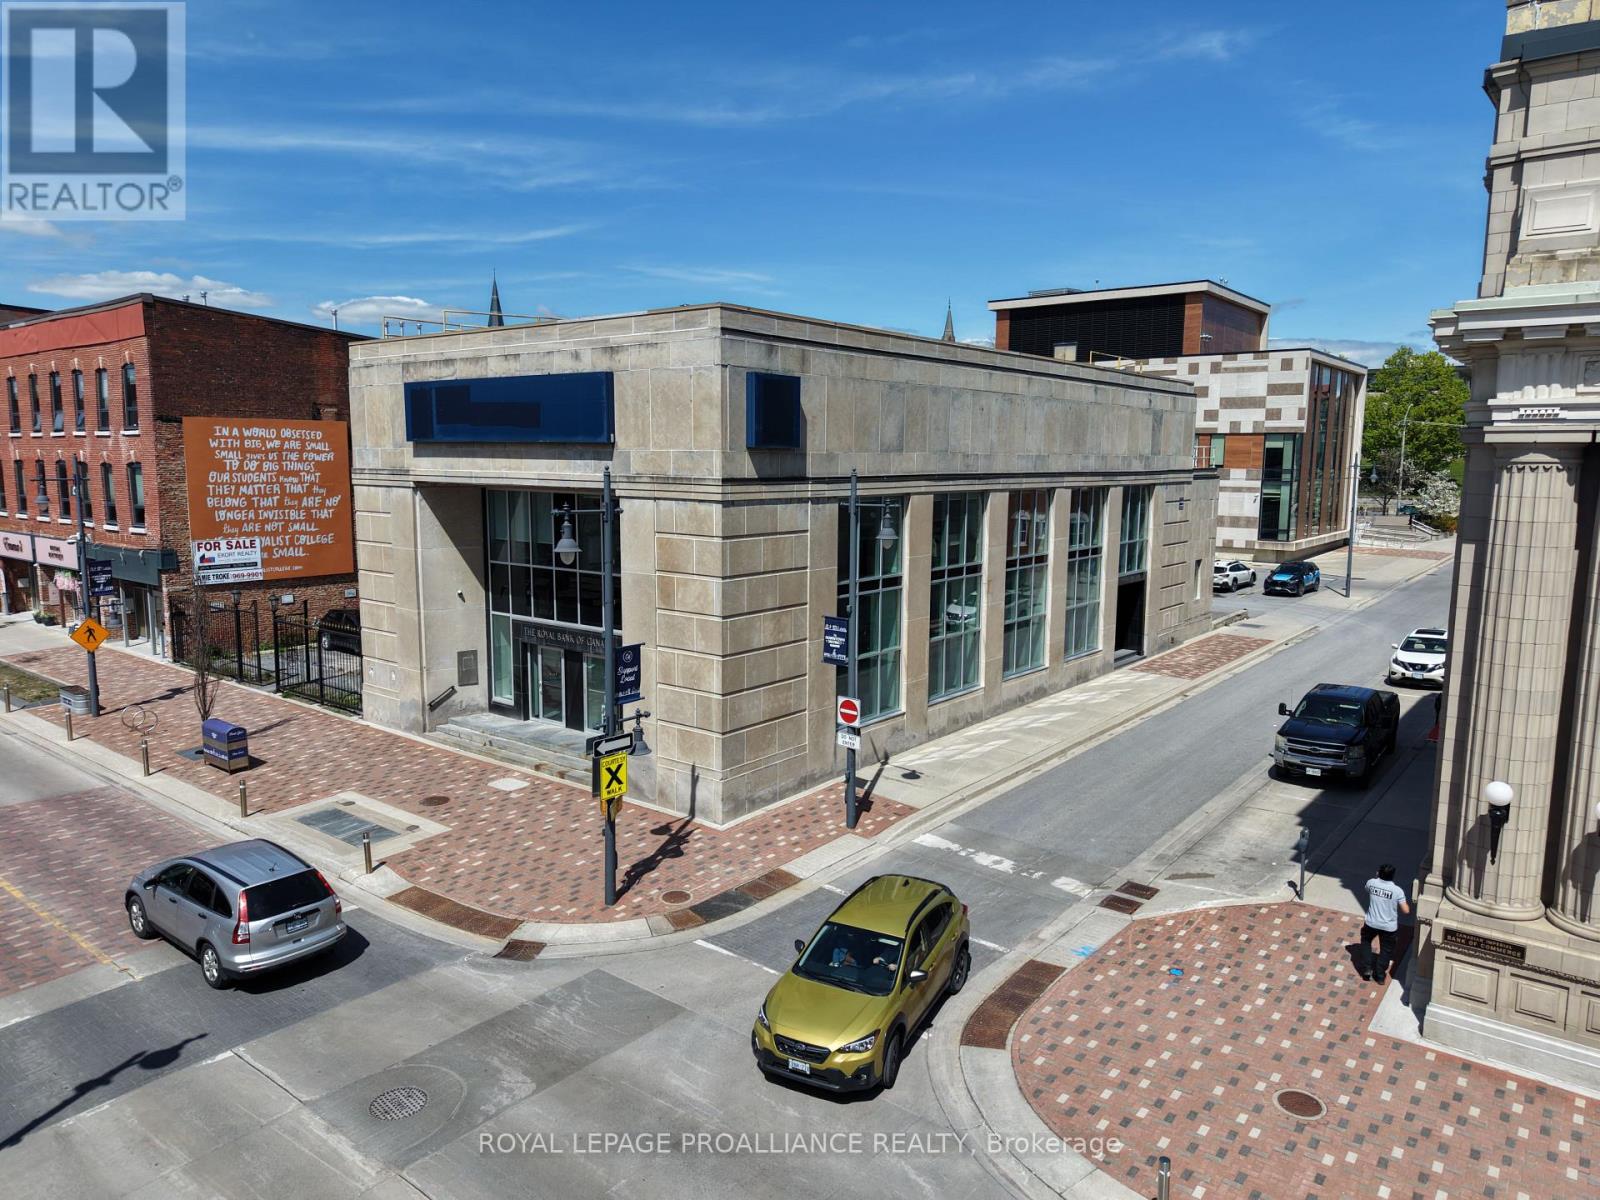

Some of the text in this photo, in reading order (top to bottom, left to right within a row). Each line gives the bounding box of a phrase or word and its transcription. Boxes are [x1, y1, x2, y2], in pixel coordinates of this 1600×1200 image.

[214, 426, 322, 440] IN A WORLD OBSESSED
[209, 438, 240, 448] WITH
[283, 440, 302, 450] ARE
[214, 450, 243, 460] SMALL
[268, 452, 279, 460] US
[282, 451, 300, 461] THE
[303, 452, 335, 462] POWER
[224, 460, 239, 471] TO
[243, 460, 260, 471] DO
[262, 461, 279, 471] BIG
[208, 471, 231, 483] OUR
[232, 472, 277, 483] STUDENTS
[300, 472, 321, 483] THAT
[207, 484, 235, 496] THEY
[239, 484, 280, 496] MATTER
[284, 483, 309, 494] THAT
[206, 497, 247, 508] BELONG
[252, 496, 280, 508] THAT
[301, 496, 321, 507] ARE
[325, 495, 342, 507] NO
[214, 509, 335, 521] LONGER INVISIBLE THAT
[242, 522, 262, 532] ARE
[264, 522, 285, 533] NOT
[287, 522, 320, 532] SMALL
[294, 533, 335, 545] COLLEGE
[196, 539, 257, 552] FOR SALE
[524, 627, 536, 637] THE
[537, 629, 555, 640] ROYAL
[558, 632, 574, 643] BANK
[576, 635, 585, 645] OF
[602, 756, 626, 768] COURTESY
[605, 763, 624, 789] X
[607, 786, 622, 796] WALK
[1456, 932, 1484, 942] CANADIAN
[1447, 935, 1466, 944] BANK
[1480, 943, 1522, 957] COMMERCE
